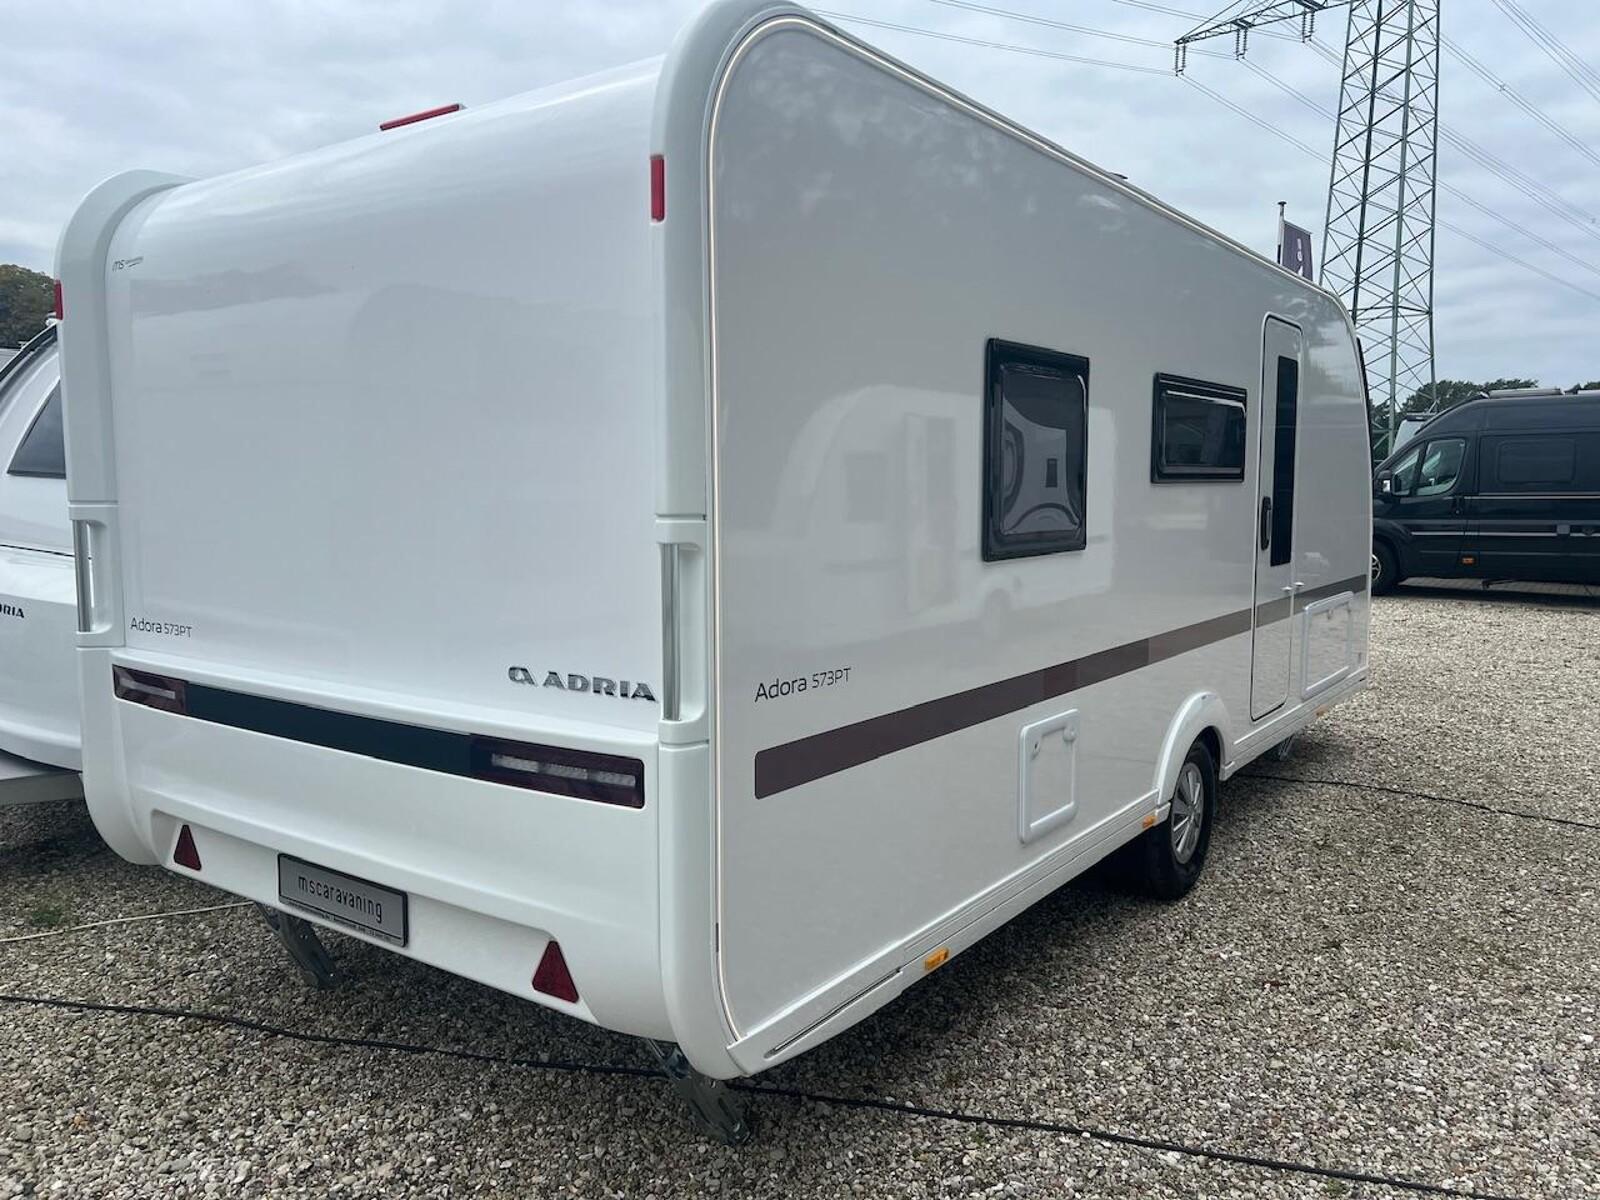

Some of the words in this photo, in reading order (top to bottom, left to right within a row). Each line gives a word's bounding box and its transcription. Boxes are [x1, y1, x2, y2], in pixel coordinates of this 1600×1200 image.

[130, 617, 162, 634] Adora
[164, 622, 192, 638] 573PT
[542, 670, 657, 702] ADRIA
[754, 678, 807, 703] Adora
[812, 667, 852, 689] 573PT
[298, 876, 382, 924] mscaravaning
